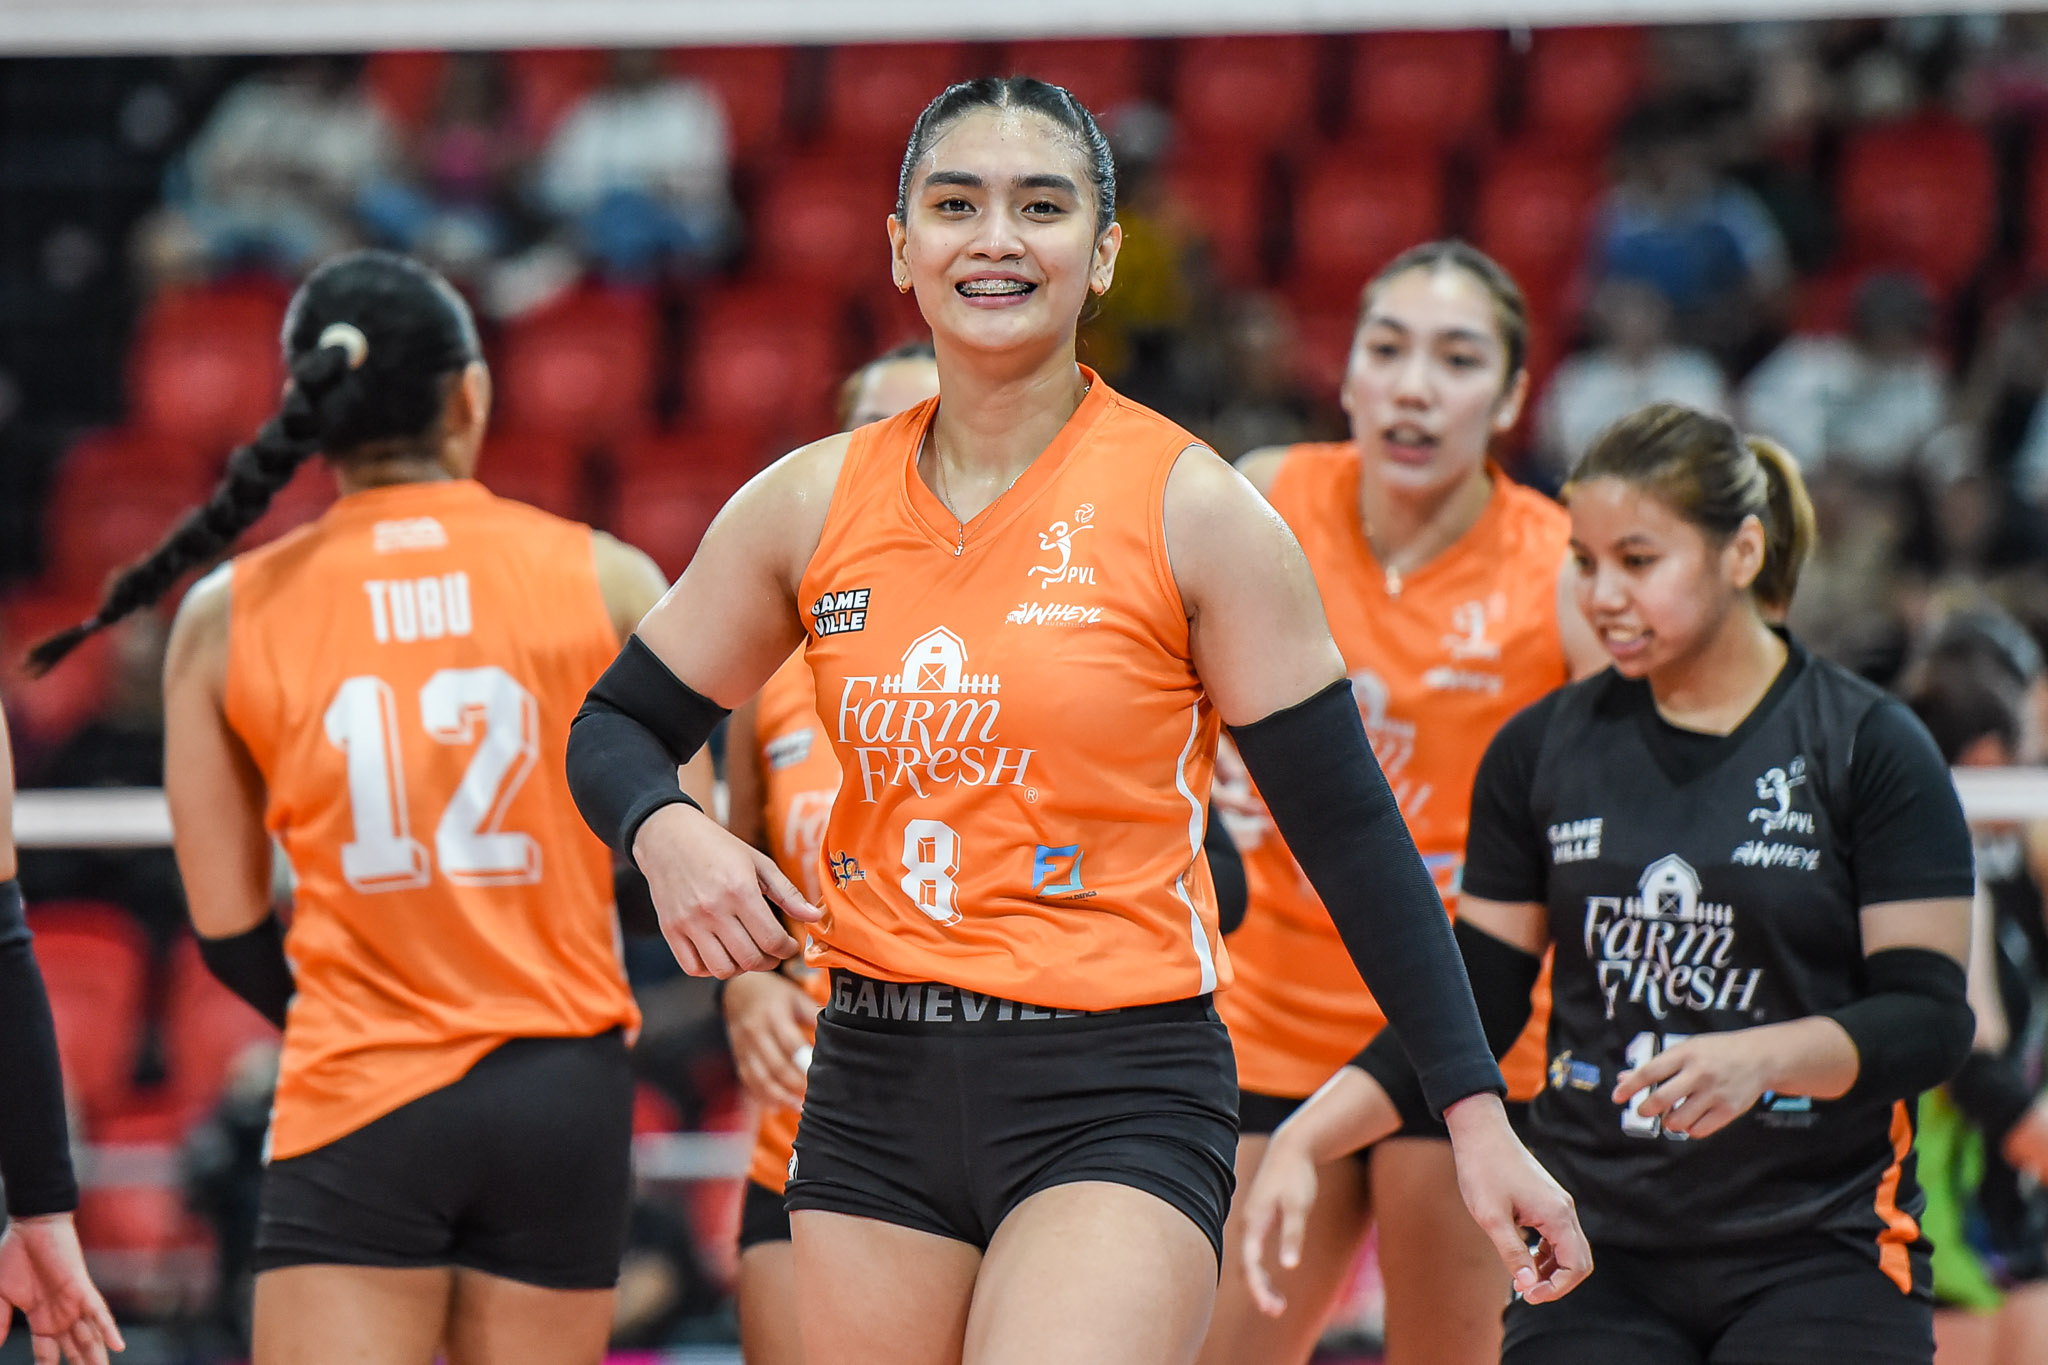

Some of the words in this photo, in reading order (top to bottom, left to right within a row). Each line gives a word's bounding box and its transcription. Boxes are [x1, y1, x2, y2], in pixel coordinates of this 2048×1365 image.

[1067, 566, 1097, 585] PVL
[364, 571, 472, 643] TUBU
[812, 590, 869, 615] GAME
[1022, 602, 1102, 626] WHEYL
[814, 611, 866, 636] VILLE
[323, 666, 543, 894] 12
[1548, 817, 1603, 843] GAME
[1785, 810, 1815, 834] PVL
[900, 818, 963, 927] 8
